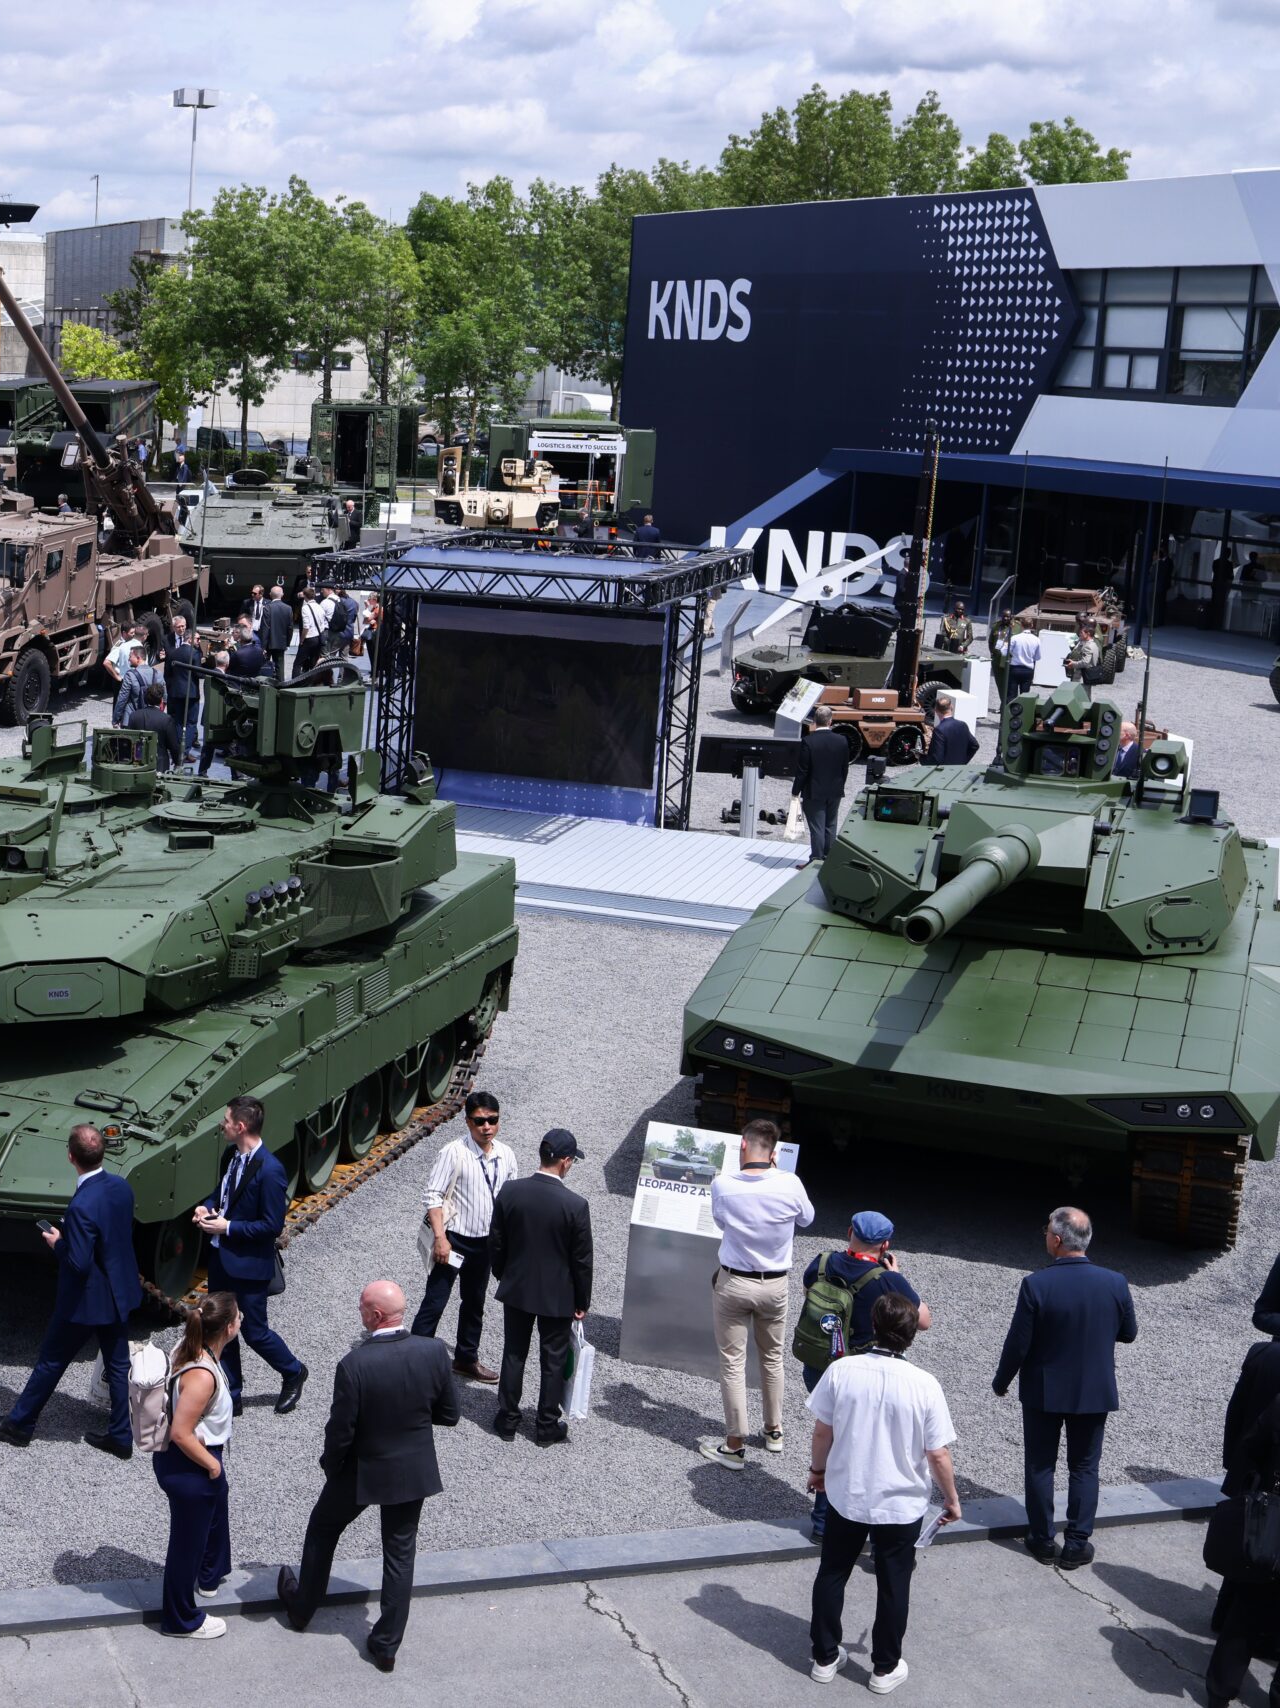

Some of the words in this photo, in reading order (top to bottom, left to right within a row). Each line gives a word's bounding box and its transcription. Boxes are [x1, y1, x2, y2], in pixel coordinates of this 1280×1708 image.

[648, 278, 752, 342] KNDS
[48, 990, 69, 998] KNDS
[927, 1081, 985, 1104] KNDS
[638, 1177, 688, 1193] LEOPARD
[690, 1186, 697, 1195] 2
